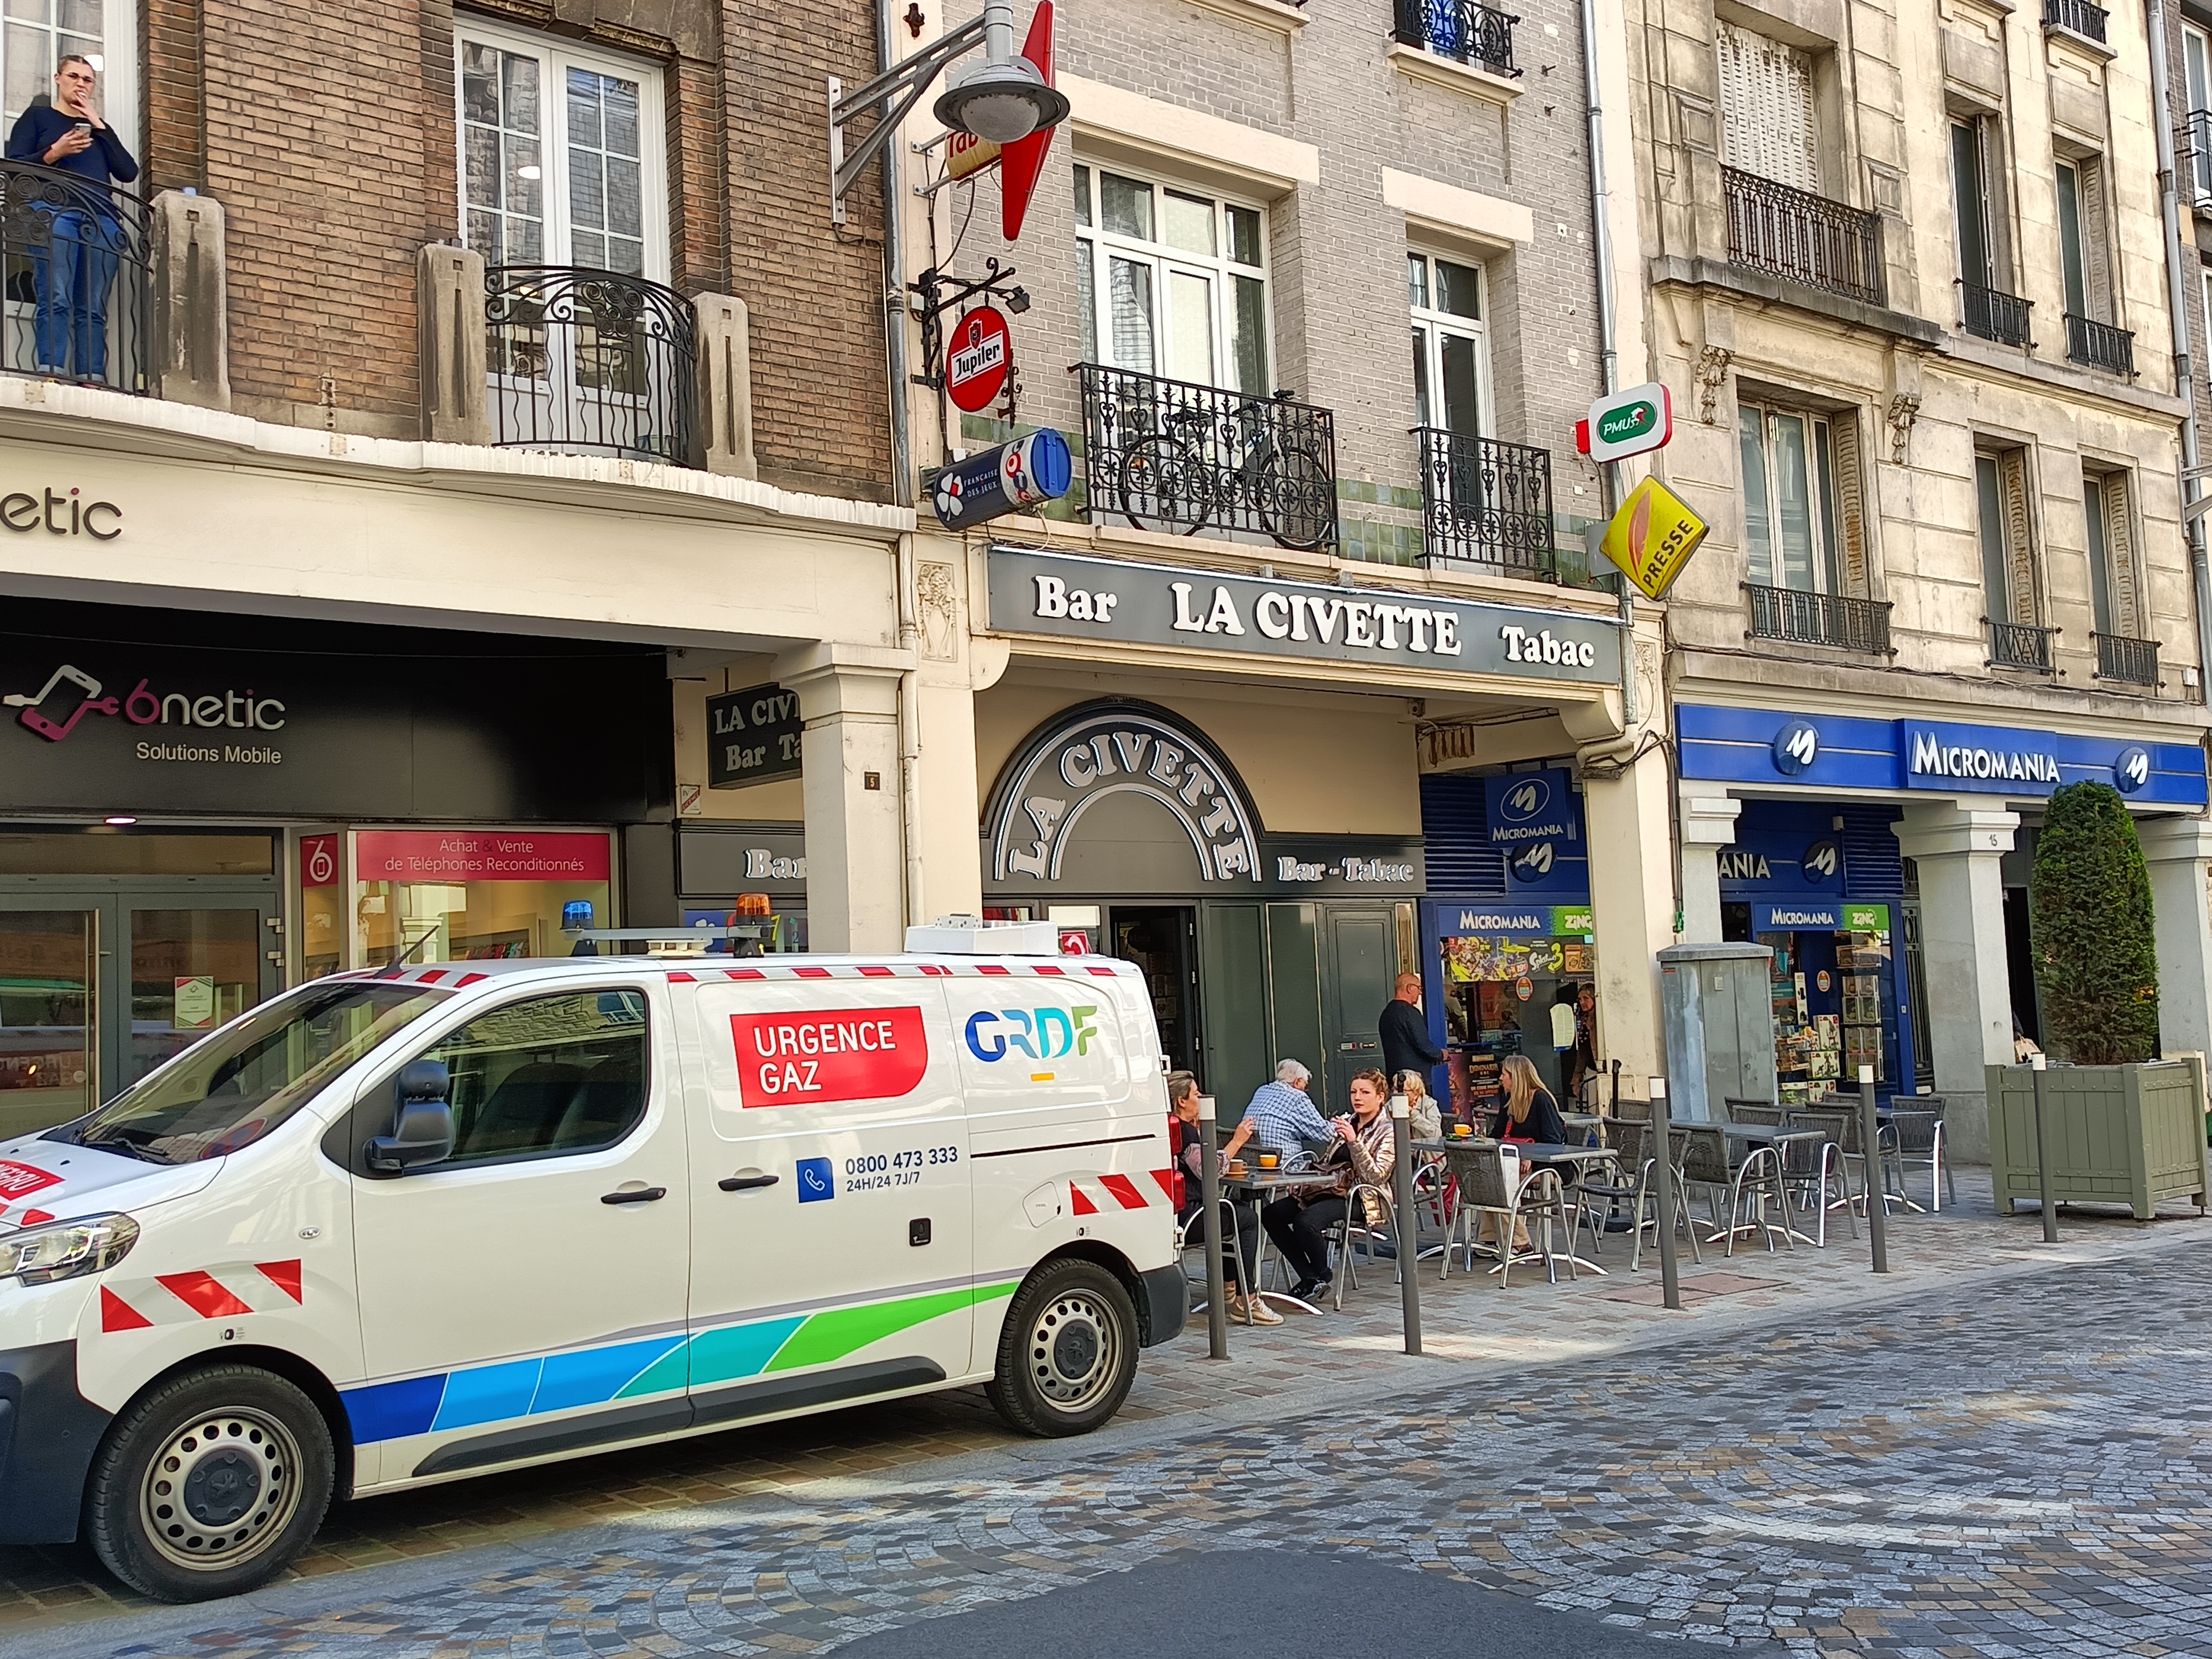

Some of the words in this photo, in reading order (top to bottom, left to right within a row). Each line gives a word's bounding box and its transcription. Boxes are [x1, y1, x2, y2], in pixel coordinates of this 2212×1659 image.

[956, 344, 1000, 379] Jupiler
[1604, 418, 1634, 436] PMU
[967, 488, 979, 497] DES
[982, 481, 997, 494] JEUX
[1642, 519, 1694, 589] PRESSE
[1034, 575, 1118, 623] Bar
[1171, 582, 1245, 636] LA
[1255, 591, 1462, 656] CIVETTE
[1501, 625, 1595, 667] Tabac
[126, 679, 285, 730] 6netic
[714, 705, 745, 734] LA
[136, 742, 219, 762] Solutions
[225, 745, 281, 764] Mobile
[726, 744, 766, 771] Bar
[1910, 731, 2061, 783] MICROMANIA
[870, 777, 875, 787] 5
[1009, 796, 1067, 880] LA
[1061, 731, 1250, 880] CIVETTE
[439, 838, 478, 853] Achat
[483, 840, 493, 853] &
[497, 839, 534, 854] Vente
[1492, 823, 1563, 842] MICROMANIA
[1989, 834, 1997, 847] 15
[385, 857, 403, 871] de
[407, 856, 482, 874] Téléphones
[487, 857, 585, 872] Reconditionnés
[744, 848, 806, 879] Bar
[1277, 856, 1326, 882] Bar
[1342, 857, 1414, 883] Tabac
[1459, 910, 1541, 930] MICROMANIA
[1771, 907, 1834, 925] MICROMANIA
[753, 1020, 896, 1057] URGENCE
[965, 1005, 1098, 1062] GRDF
[759, 1060, 822, 1094] GAZ
[846, 1155, 888, 1175] 0800
[893, 1150, 923, 1170] 473
[928, 1146, 958, 1165] 333
[846, 1176, 891, 1192] 24H/24
[895, 1171, 920, 1186] 7J/7
